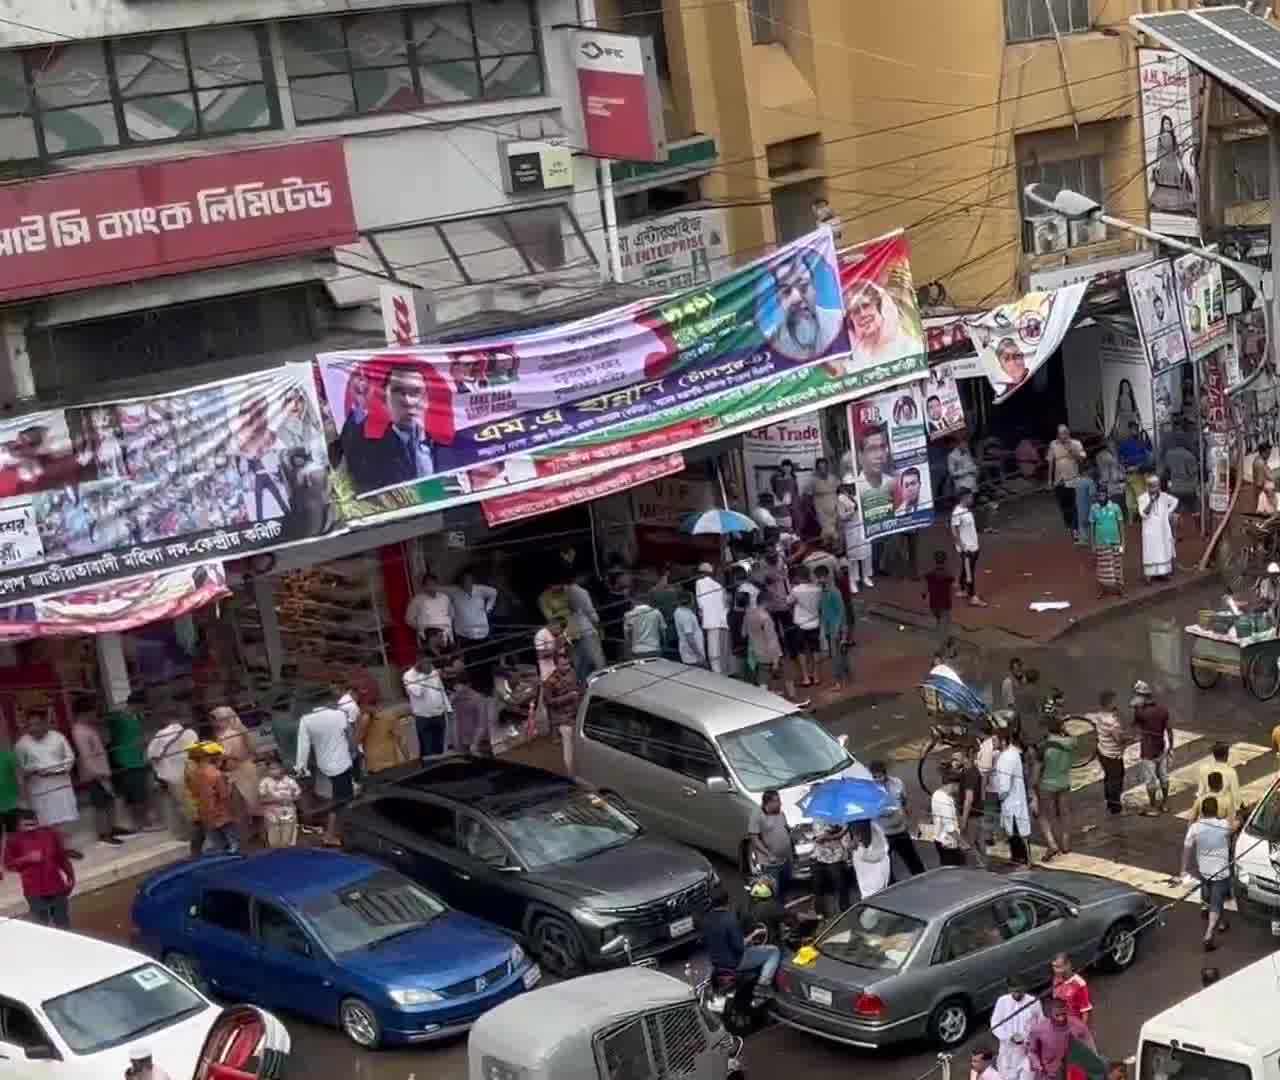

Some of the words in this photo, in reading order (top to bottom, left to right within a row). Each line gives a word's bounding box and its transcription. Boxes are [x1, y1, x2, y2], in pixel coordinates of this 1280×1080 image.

[50, 209, 90, 249] সি
[96, 201, 192, 241] ব্যাংক
[197, 176, 332, 225] লিমিটেড
